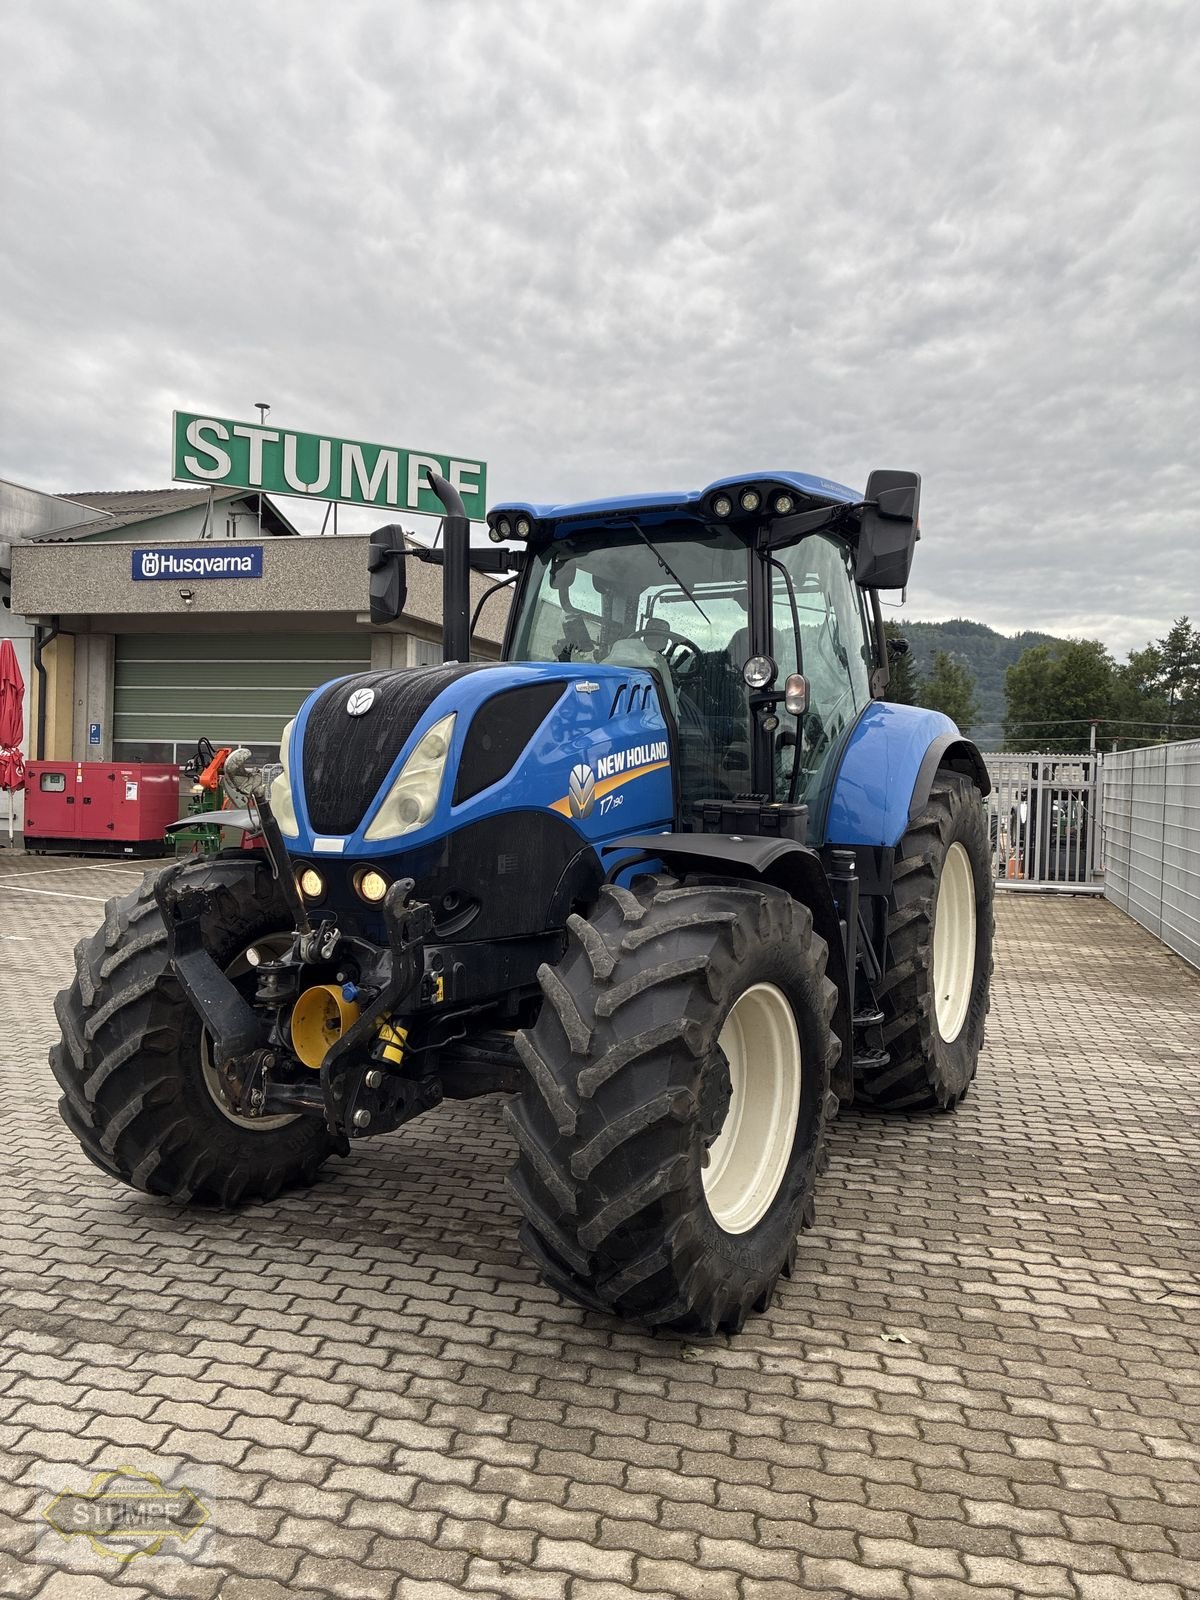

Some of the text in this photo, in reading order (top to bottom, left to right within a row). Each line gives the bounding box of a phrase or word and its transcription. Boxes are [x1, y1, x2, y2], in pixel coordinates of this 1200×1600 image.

[184, 419, 481, 507] STUMPF
[161, 555, 252, 575] Husqvarna
[597, 741, 668, 779] NEW HOLLAND
